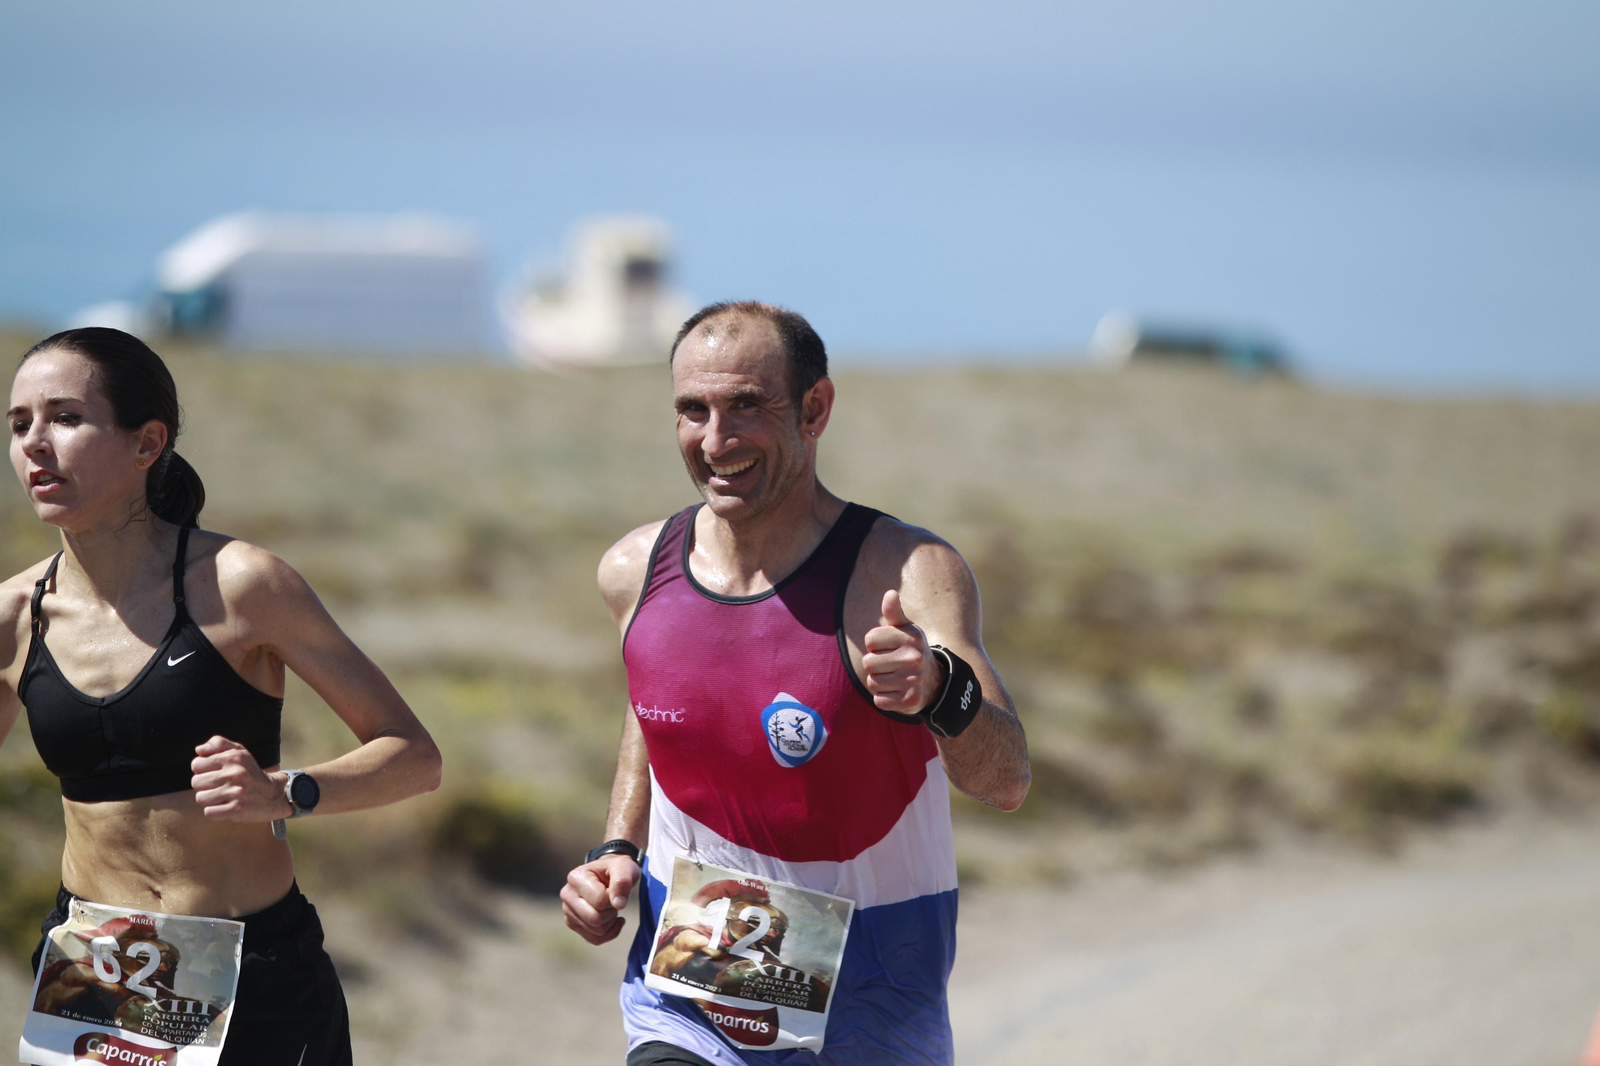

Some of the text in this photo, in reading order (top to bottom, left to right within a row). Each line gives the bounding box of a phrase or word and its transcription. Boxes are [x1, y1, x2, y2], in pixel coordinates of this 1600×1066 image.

[706, 897, 771, 962] 12
[91, 936, 161, 999] 62
[746, 960, 814, 985] XIII
[671, 972, 680, 980] 21
[680, 975, 688, 983] de
[688, 979, 704, 988] enero
[743, 980, 810, 997] POPULAR
[744, 973, 812, 992] CARRERA
[740, 991, 760, 1000] DEL
[756, 988, 810, 1002] ESPARTANOS
[143, 998, 212, 1016] XIII
[61, 1009, 71, 1017] 21
[72, 1011, 82, 1019] de
[82, 1015, 103, 1024] enero
[143, 1008, 211, 1024] CARRERA
[143, 1015, 208, 1032] POPULAR
[140, 1027, 160, 1038] DEL
